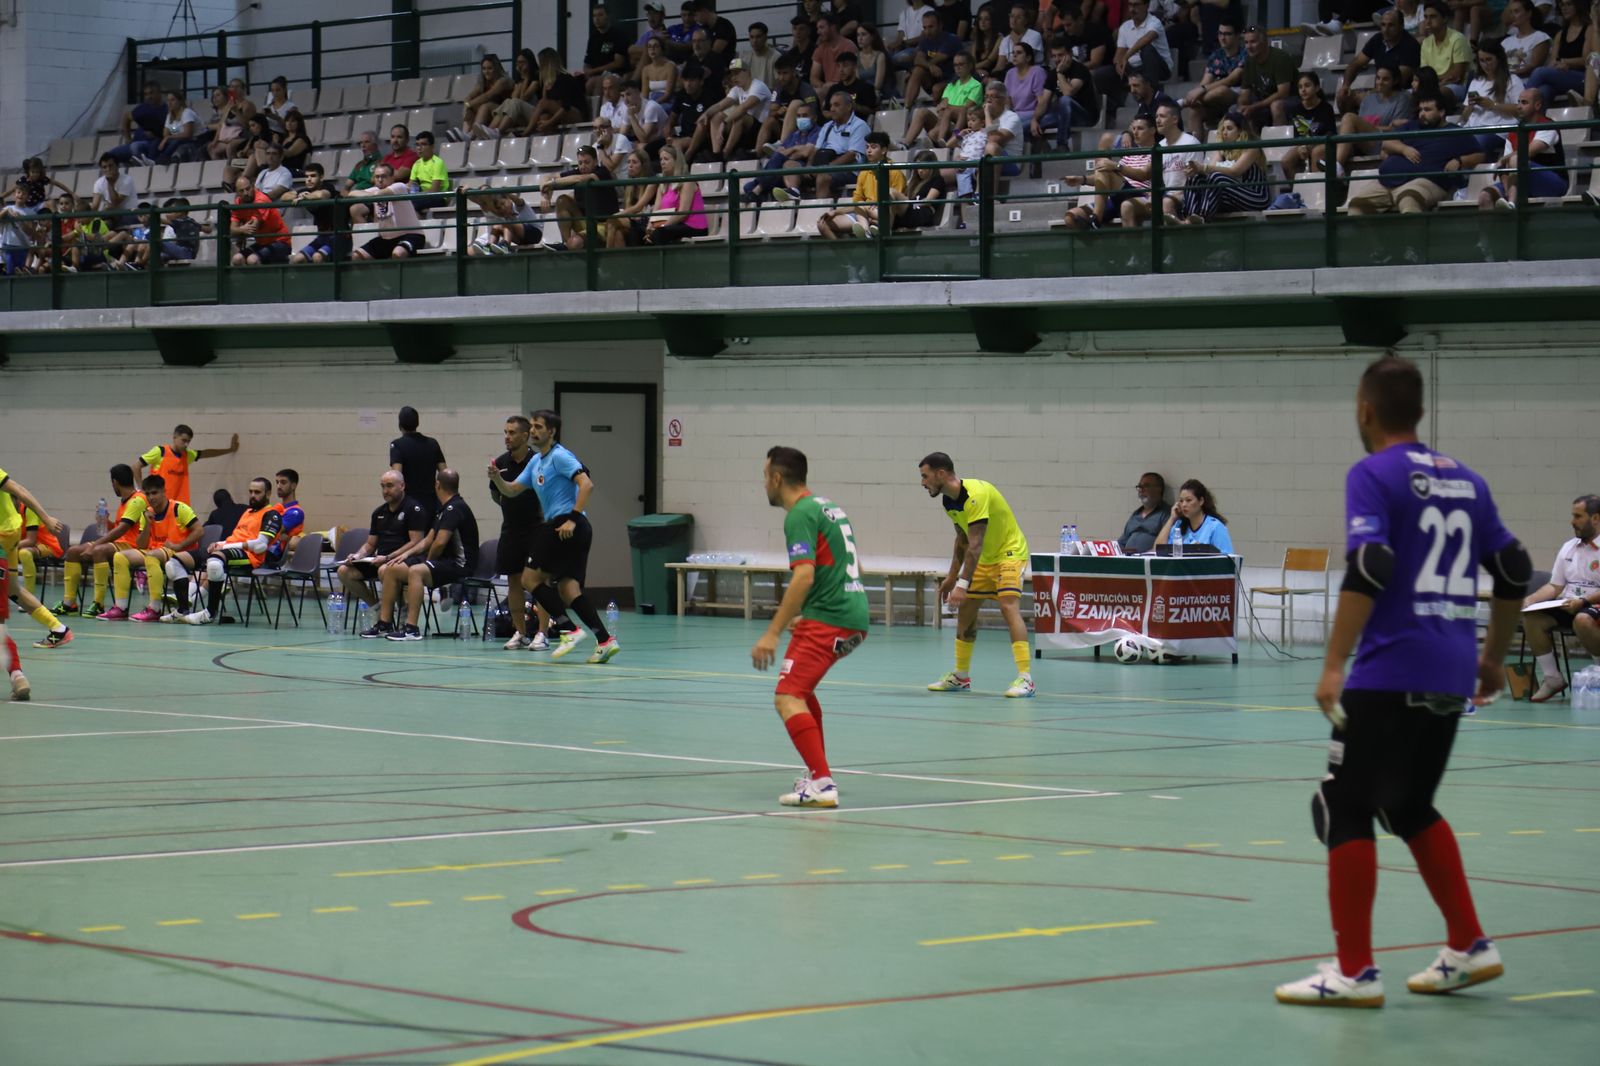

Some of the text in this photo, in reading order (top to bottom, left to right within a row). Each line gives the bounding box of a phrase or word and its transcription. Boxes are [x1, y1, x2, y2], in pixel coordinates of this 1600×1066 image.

[840, 524, 859, 579] 5
[1095, 543, 1110, 554] 5
[1415, 506, 1474, 596] 22
[1039, 592, 1051, 600] DE
[1080, 593, 1143, 603] DIPUTACIÓN DE
[1169, 594, 1231, 605] DIPUTACIÓN DE
[1076, 604, 1141, 621] ZAMORA
[1168, 606, 1230, 623] ZAMORA
